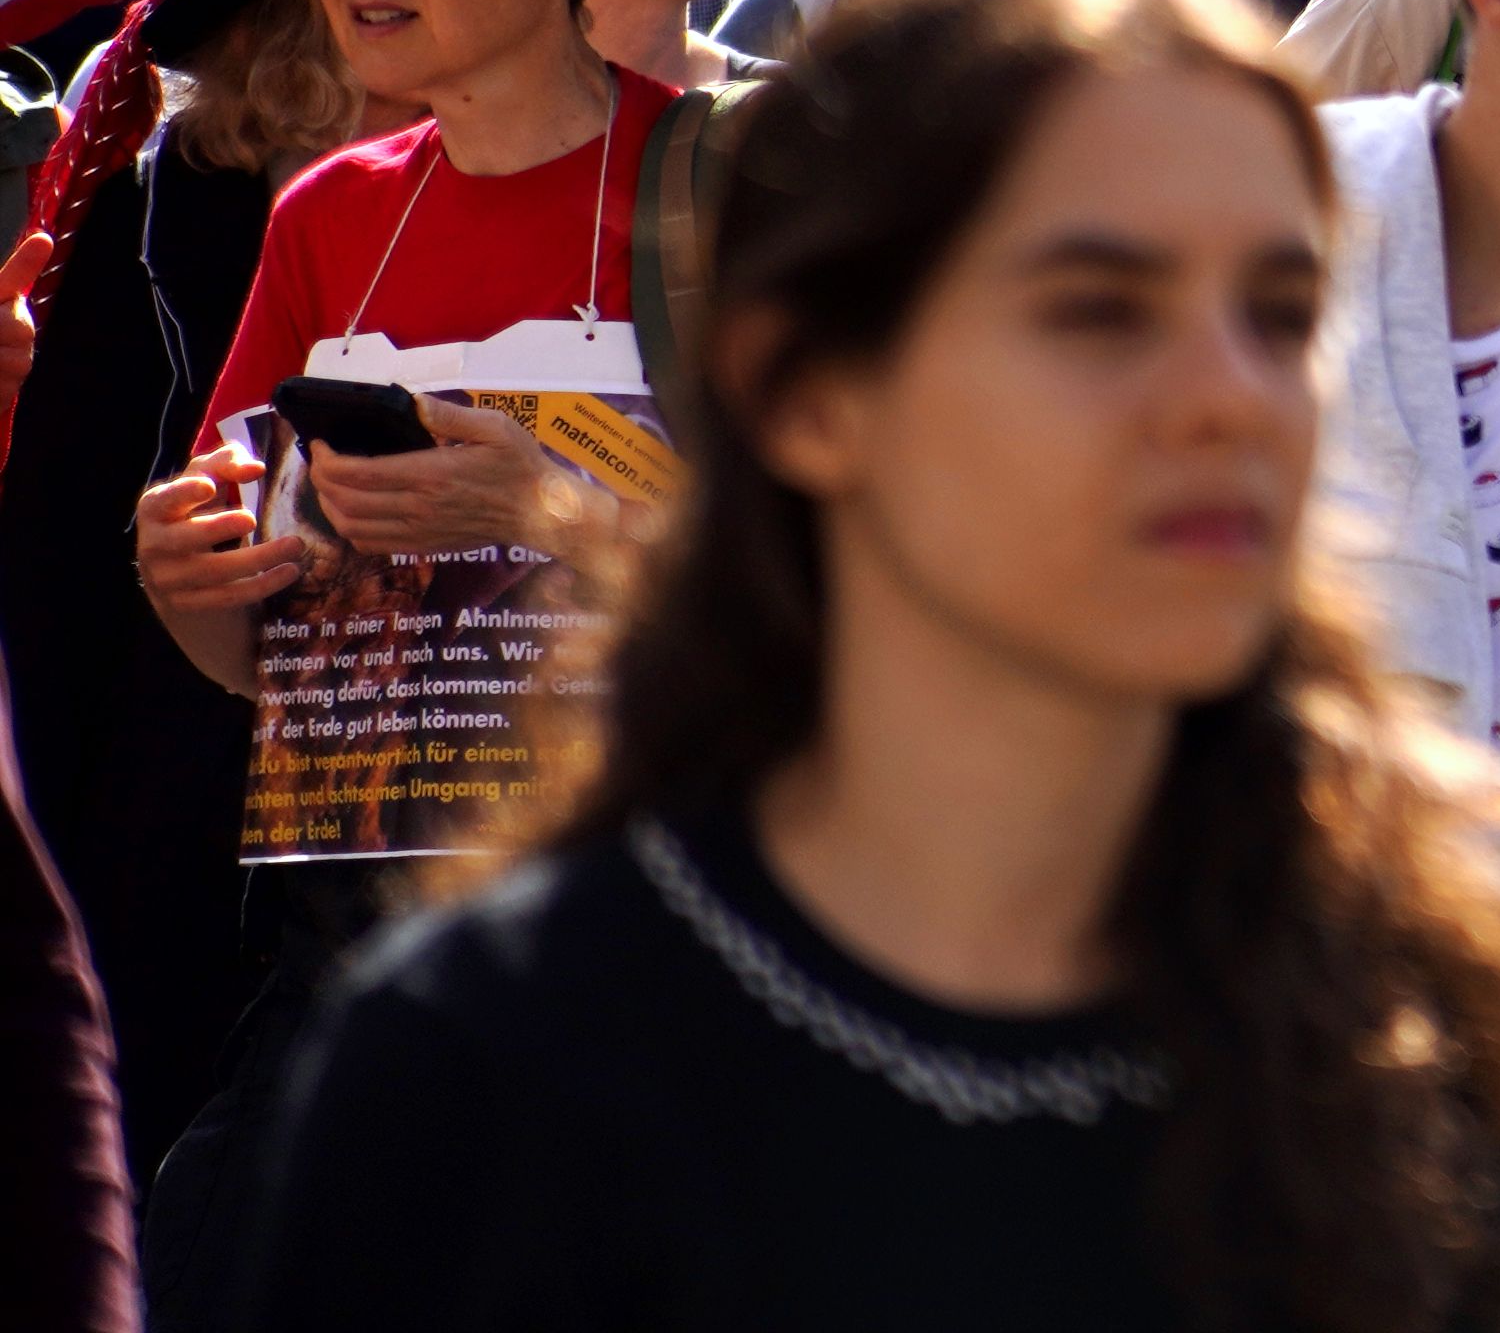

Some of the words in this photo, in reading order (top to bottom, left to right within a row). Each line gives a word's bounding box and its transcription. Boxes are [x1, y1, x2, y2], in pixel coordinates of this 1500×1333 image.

[321, 617, 336, 637] in
[346, 614, 385, 635] einer
[393, 610, 442, 637] langen
[332, 653, 357, 669] vor
[364, 644, 394, 666] und
[443, 641, 489, 661] uns.
[500, 641, 544, 661] Wir
[387, 678, 420, 699] dass
[282, 718, 304, 739] der
[309, 715, 343, 737] Erde
[347, 716, 373, 741] gut
[377, 711, 417, 733] leben
[422, 708, 511, 729] können.
[426, 741, 458, 763] für
[464, 742, 529, 763] einen
[300, 785, 325, 806] und
[410, 778, 500, 803] Umgang
[269, 820, 303, 843] der
